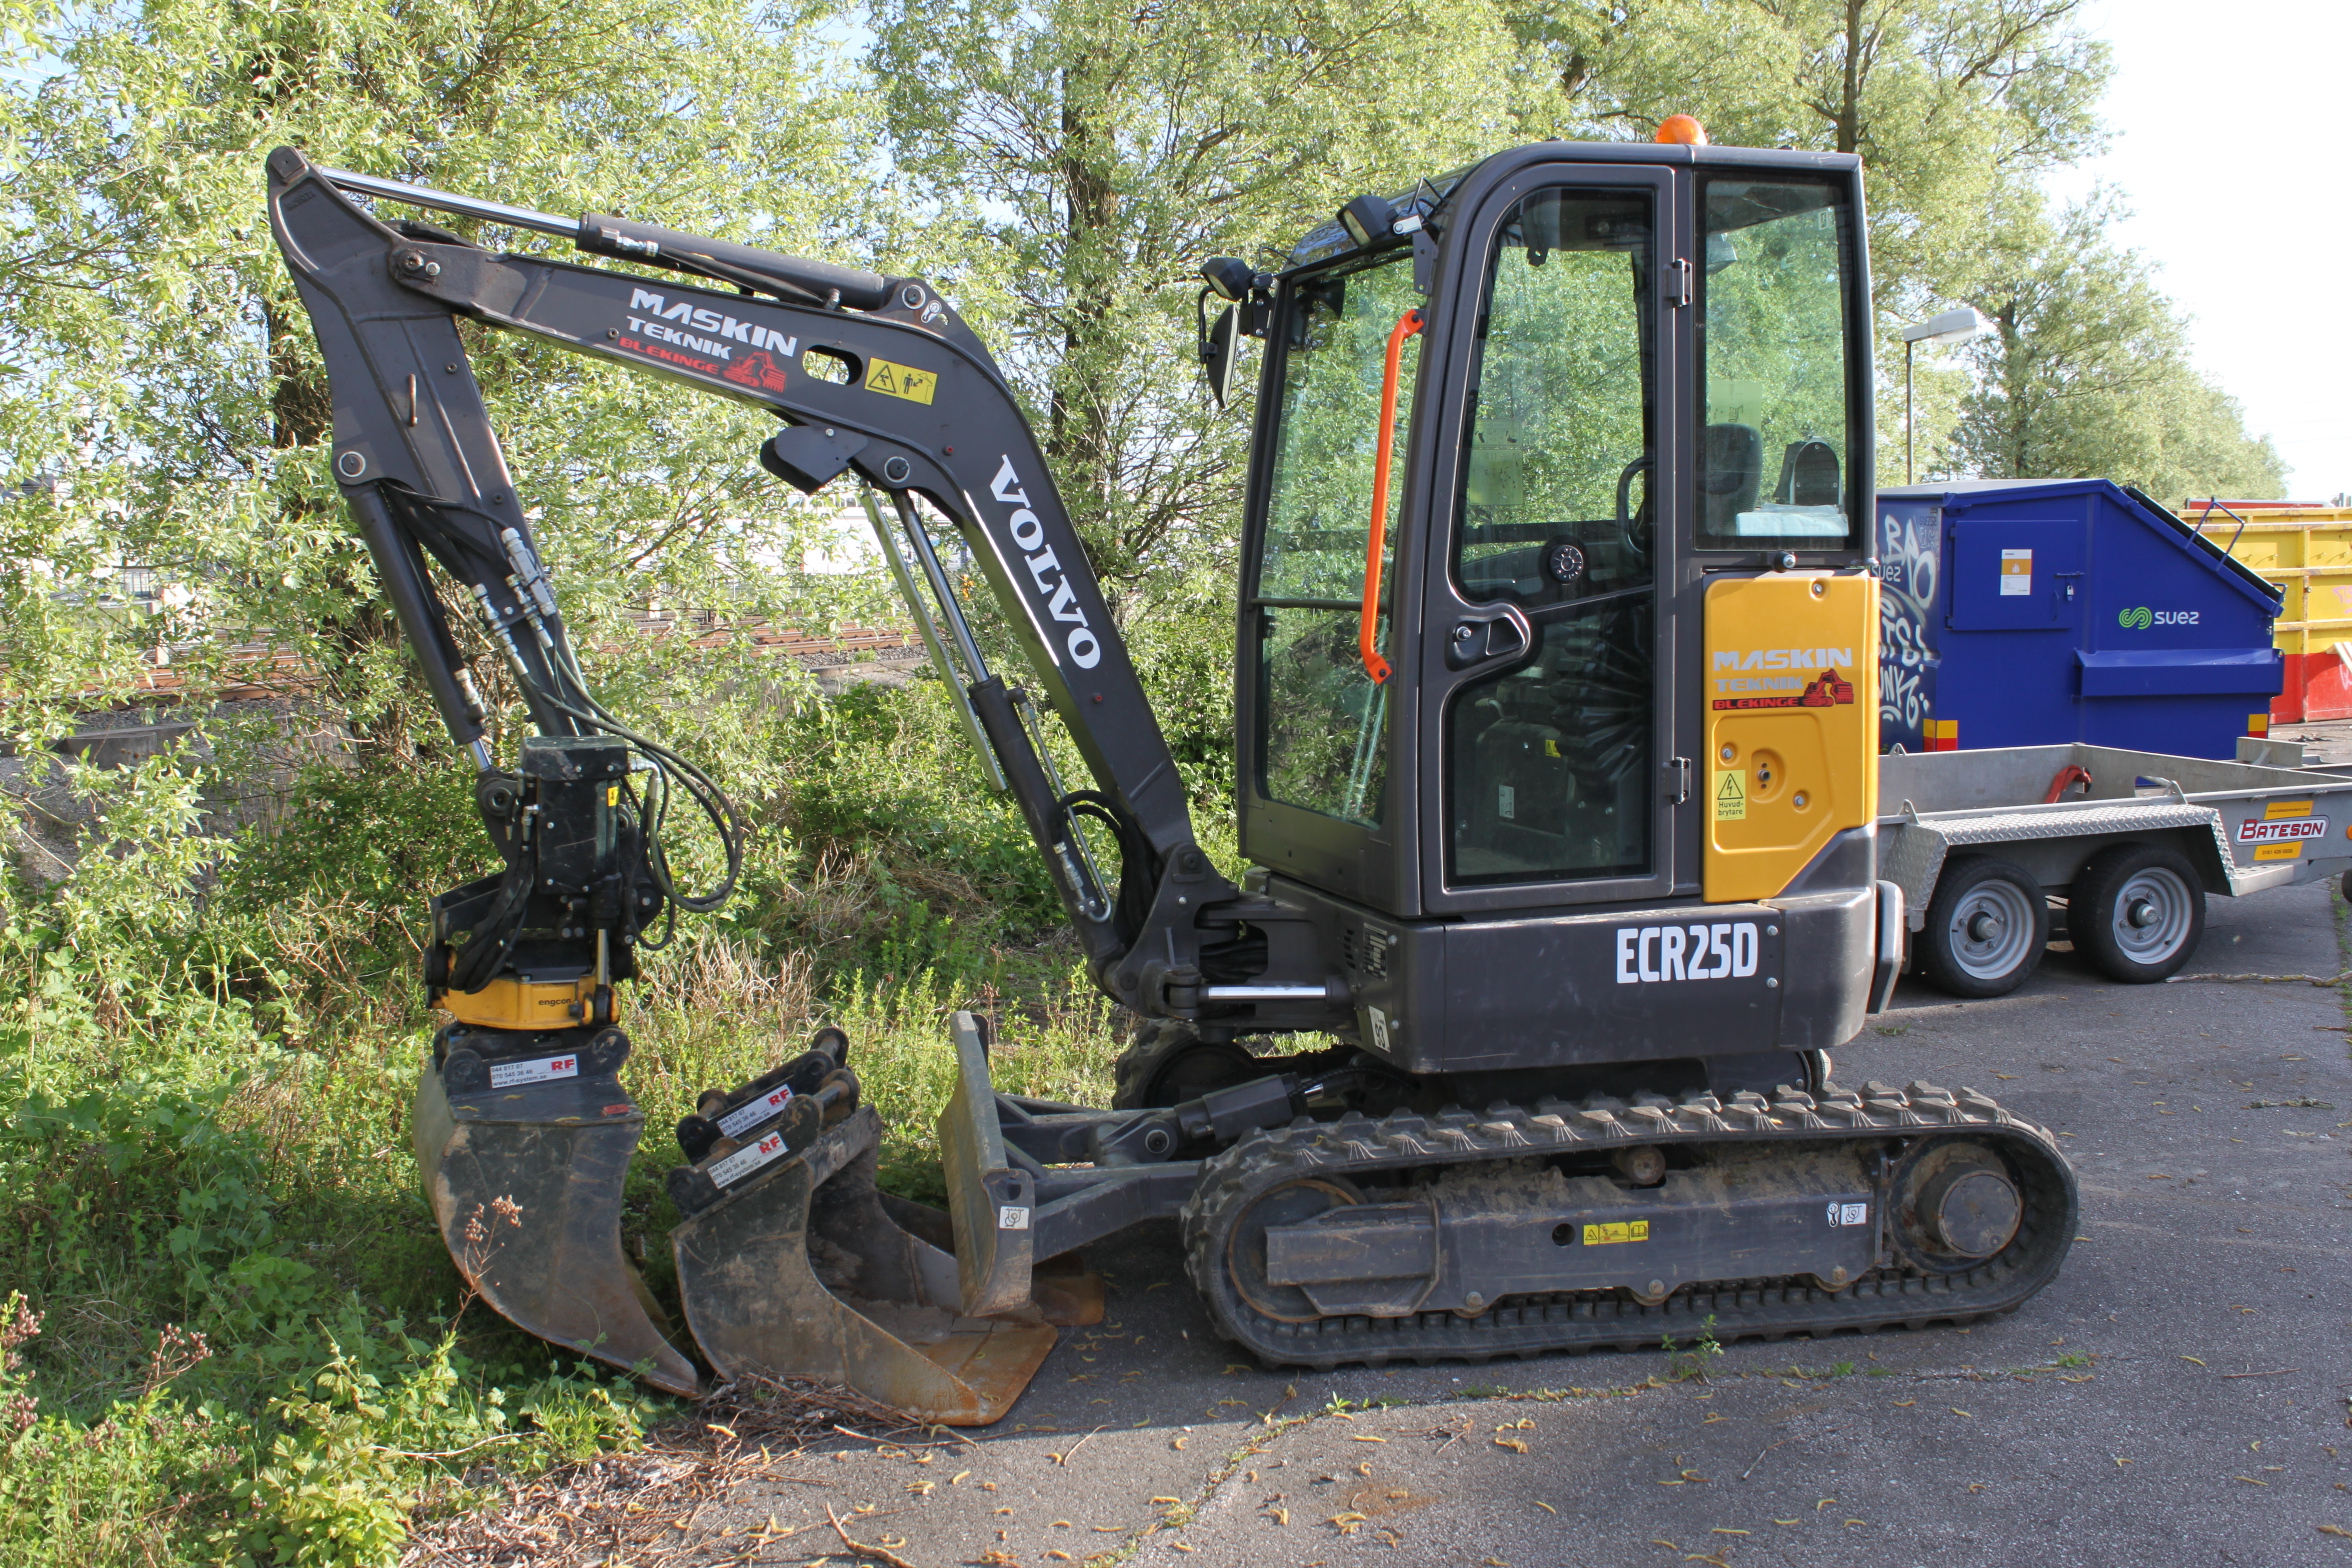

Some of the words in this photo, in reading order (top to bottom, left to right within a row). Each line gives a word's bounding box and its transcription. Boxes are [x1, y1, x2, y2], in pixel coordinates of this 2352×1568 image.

[629, 288, 797, 357] MASKIN
[626, 315, 732, 360] TEKNIK
[619, 337, 720, 375] BLEKINGE
[990, 454, 1101, 669] VOLVO
[2154, 611, 2199, 625] suez
[1713, 648, 1853, 671] MASKIN
[1714, 676, 1804, 692] TEKNIK
[1714, 697, 1799, 709] BLEKINGE
[2240, 819, 2323, 839] BATESON
[1617, 922, 1758, 983] ECR25D
[538, 998, 571, 1007] engcon
[551, 1059, 575, 1071] RF
[493, 1075, 547, 1087] www.rf-system.se
[768, 1089, 790, 1106] RF
[758, 1136, 780, 1155] RF
